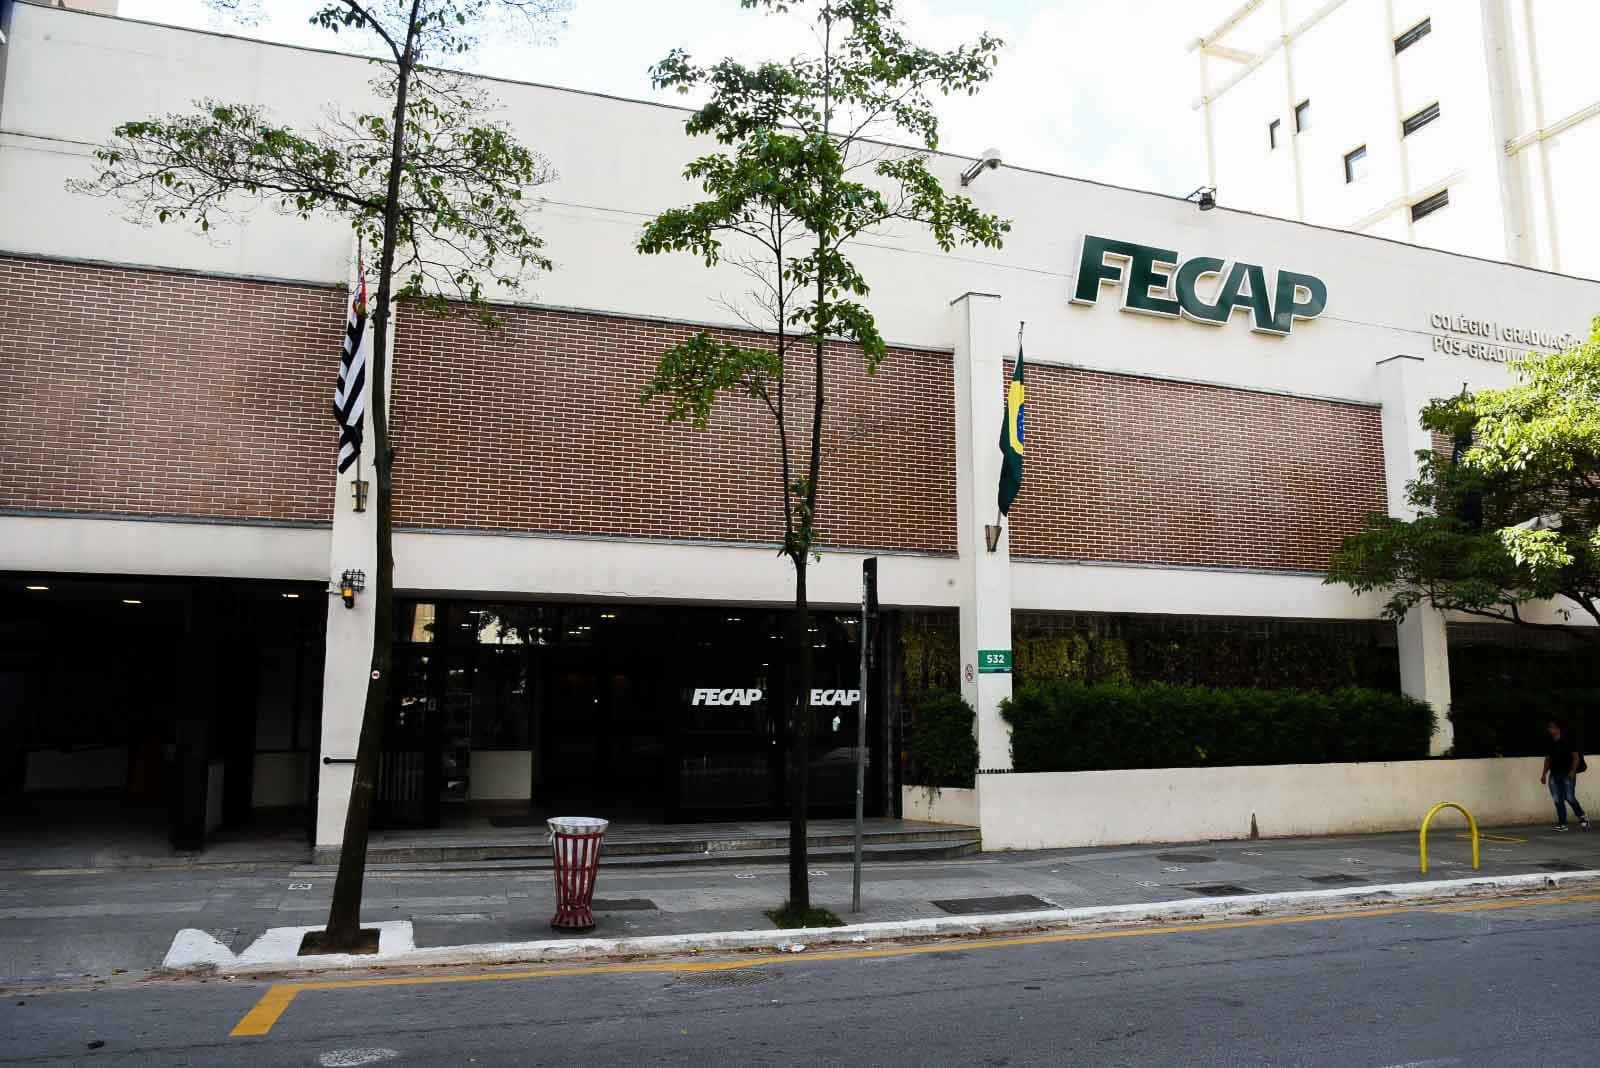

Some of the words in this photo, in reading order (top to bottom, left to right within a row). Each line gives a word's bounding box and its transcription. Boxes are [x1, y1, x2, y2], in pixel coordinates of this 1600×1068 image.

[1070, 234, 1328, 335] FECAP
[1431, 311, 1491, 337] COLÉGIO
[986, 654, 1005, 664] 532
[692, 688, 763, 706] FECAP
[796, 688, 861, 706] ECAP
